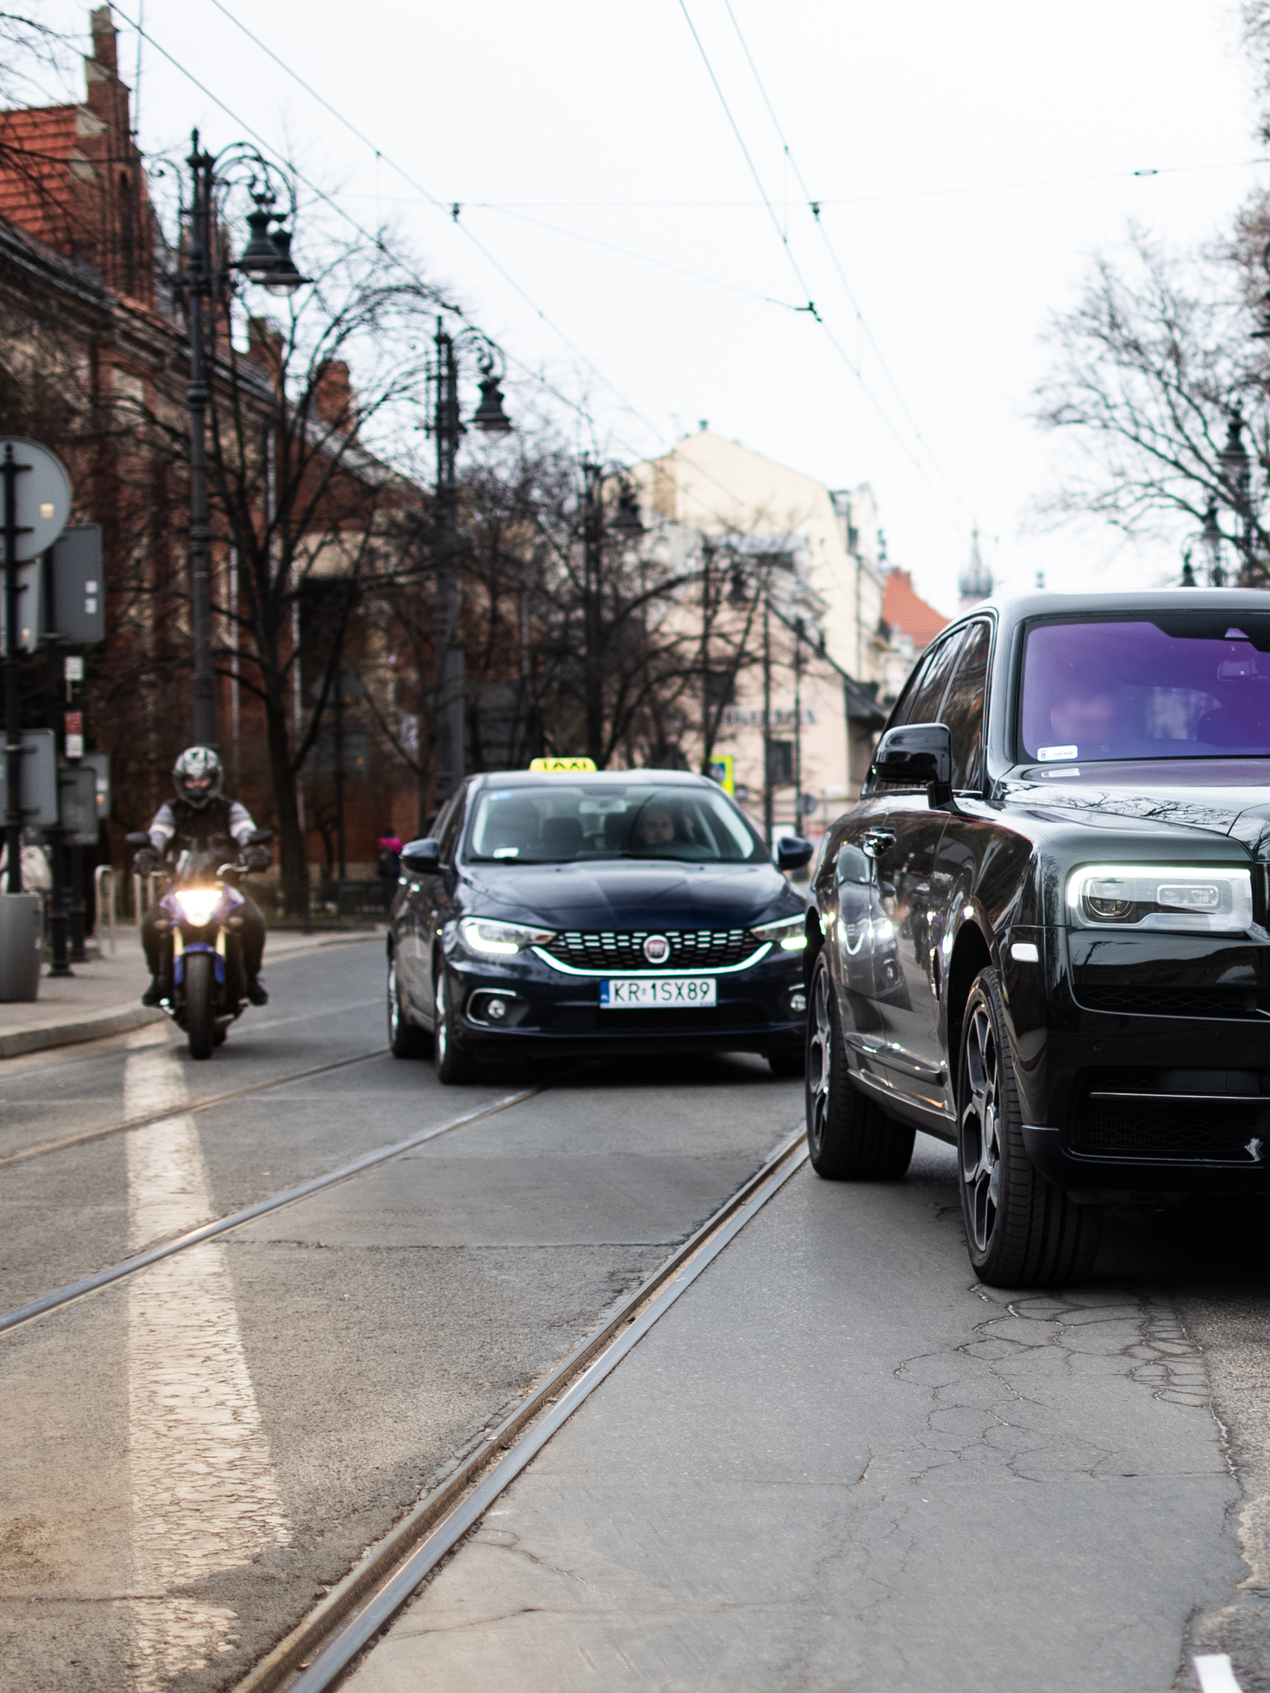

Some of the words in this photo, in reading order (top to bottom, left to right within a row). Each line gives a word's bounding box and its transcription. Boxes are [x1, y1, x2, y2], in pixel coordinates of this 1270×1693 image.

[542, 759, 587, 770] TAXI
[613, 983, 640, 1002] KR
[651, 981, 710, 1002] 1SX89
